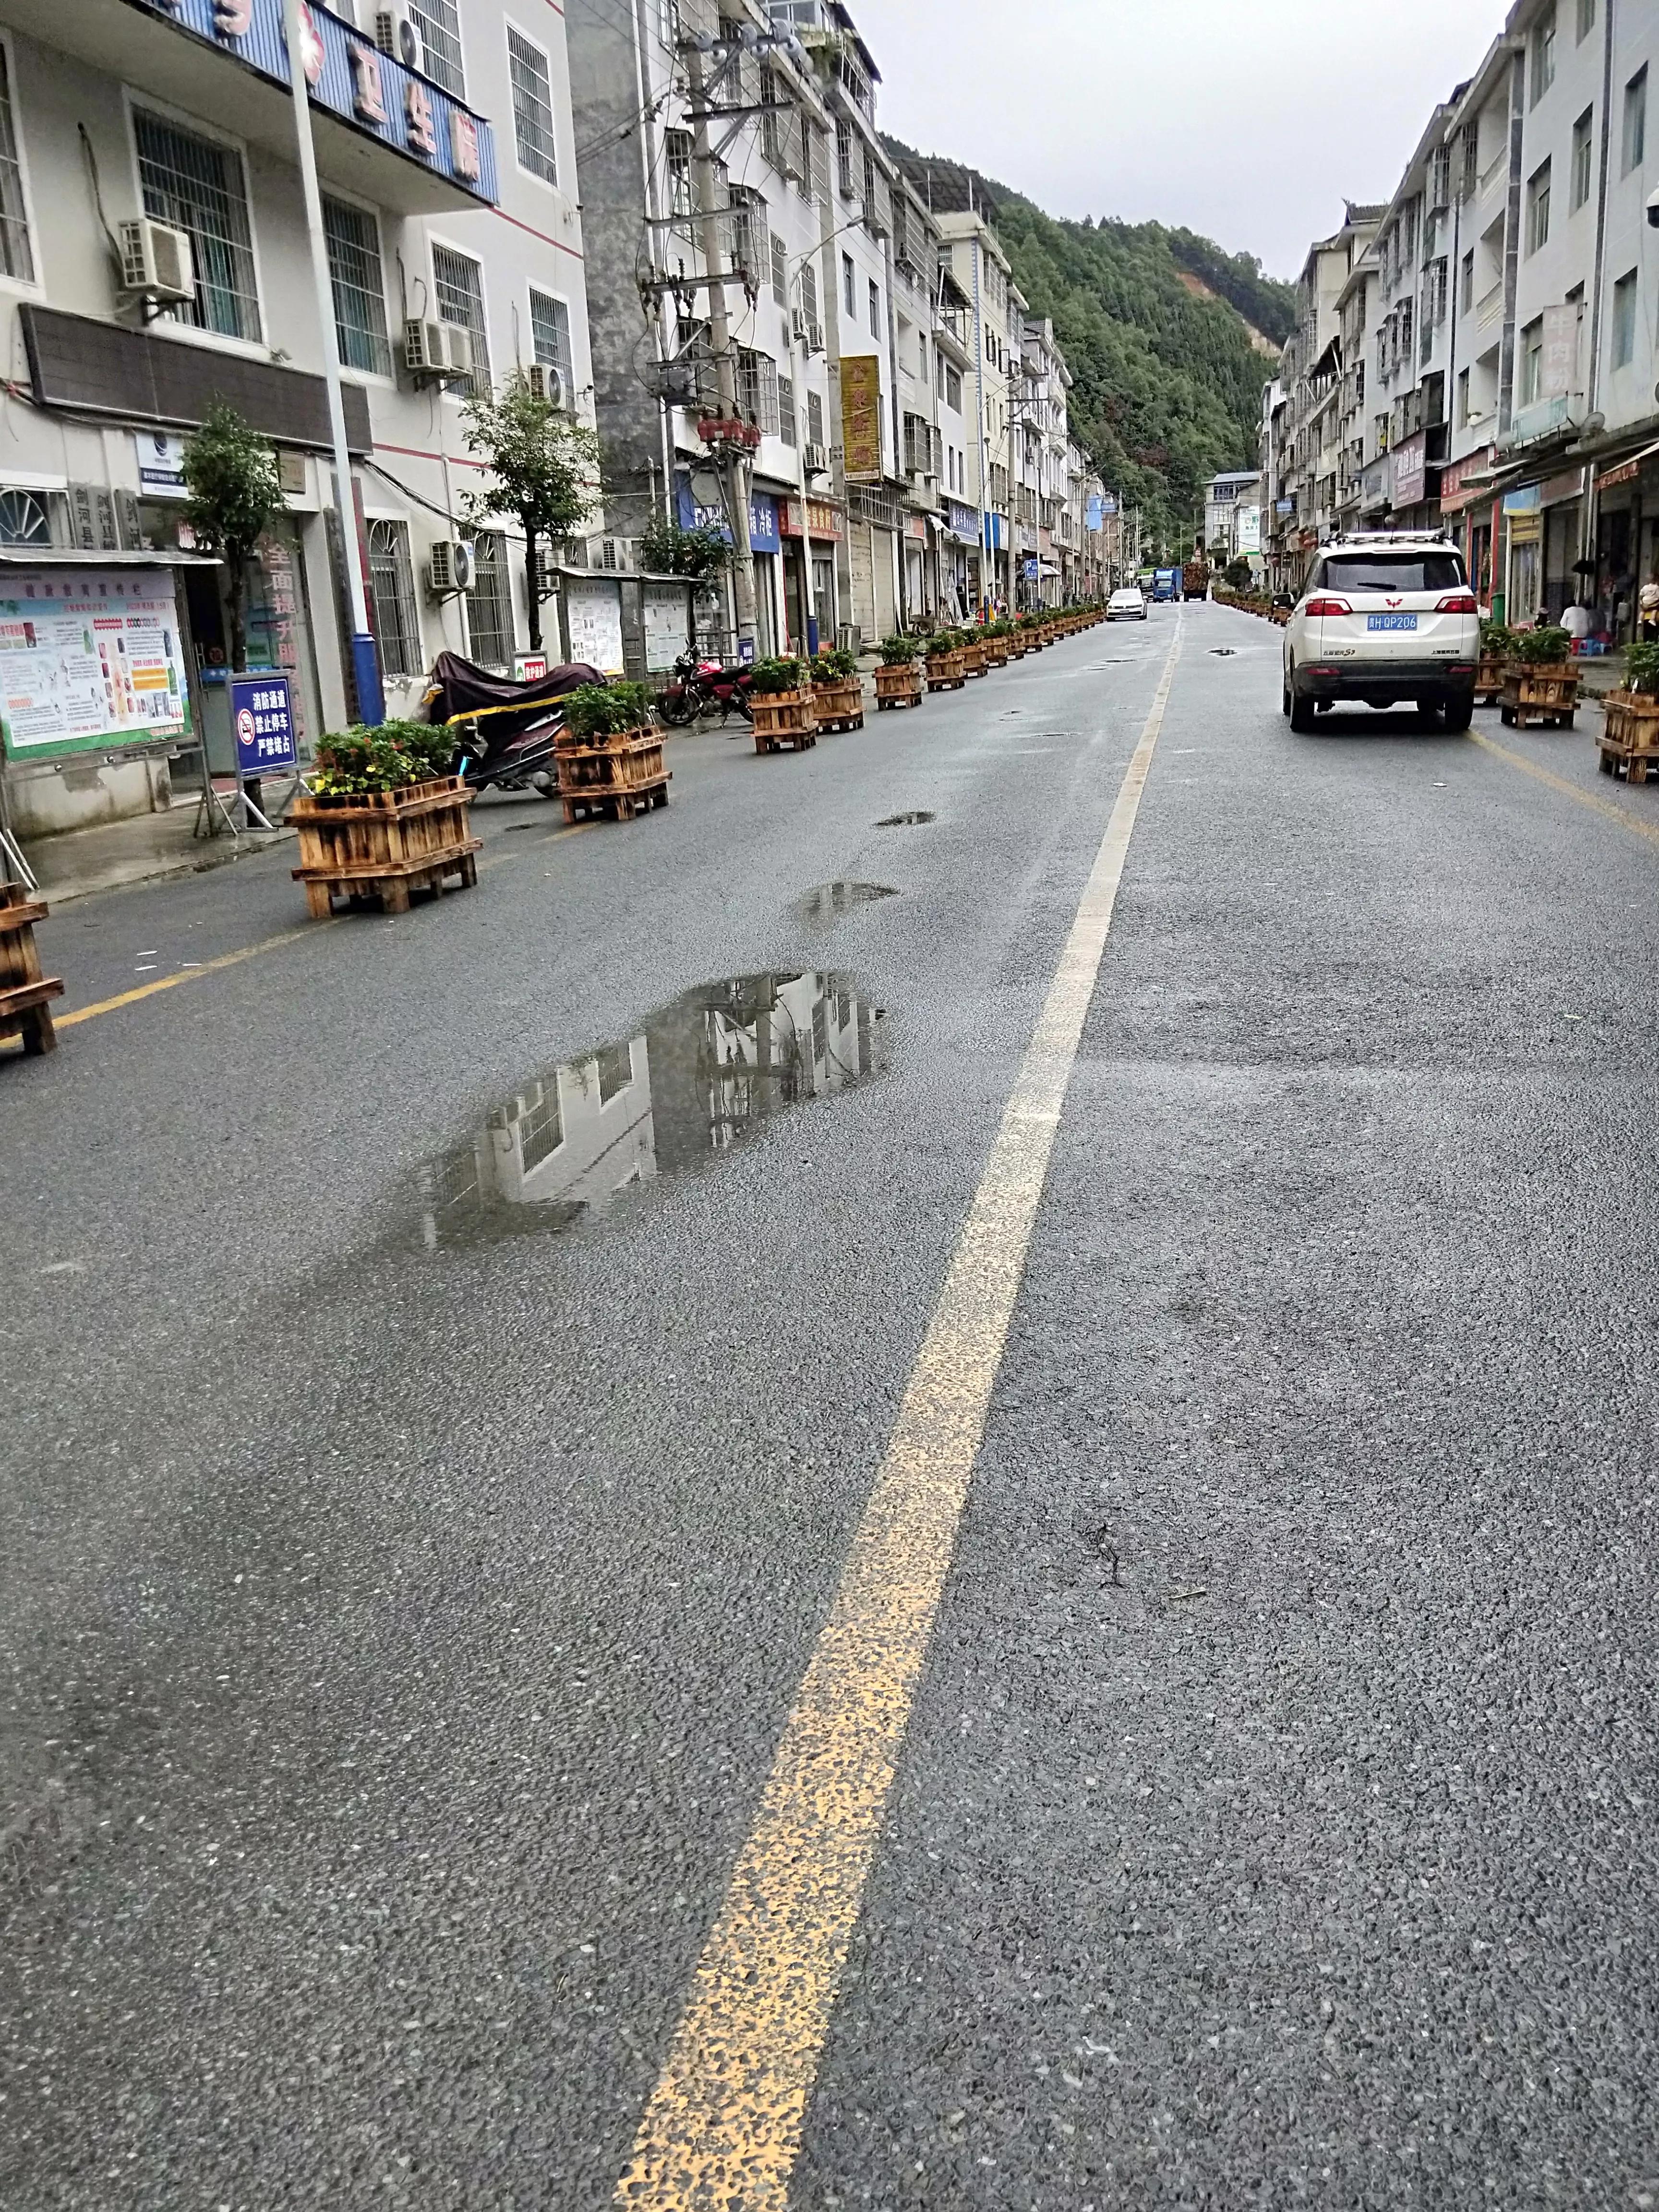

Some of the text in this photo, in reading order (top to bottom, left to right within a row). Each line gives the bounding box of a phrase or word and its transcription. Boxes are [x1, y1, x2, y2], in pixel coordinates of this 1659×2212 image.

[350, 44, 480, 182] 卫生院
[1546, 314, 1573, 390] 牛肉粉
[1026, 562, 1032, 571] P
[252, 690, 286, 711] 消防通道
[255, 712, 289, 734] 禁止停车
[257, 735, 290, 757] 严禁堵占
